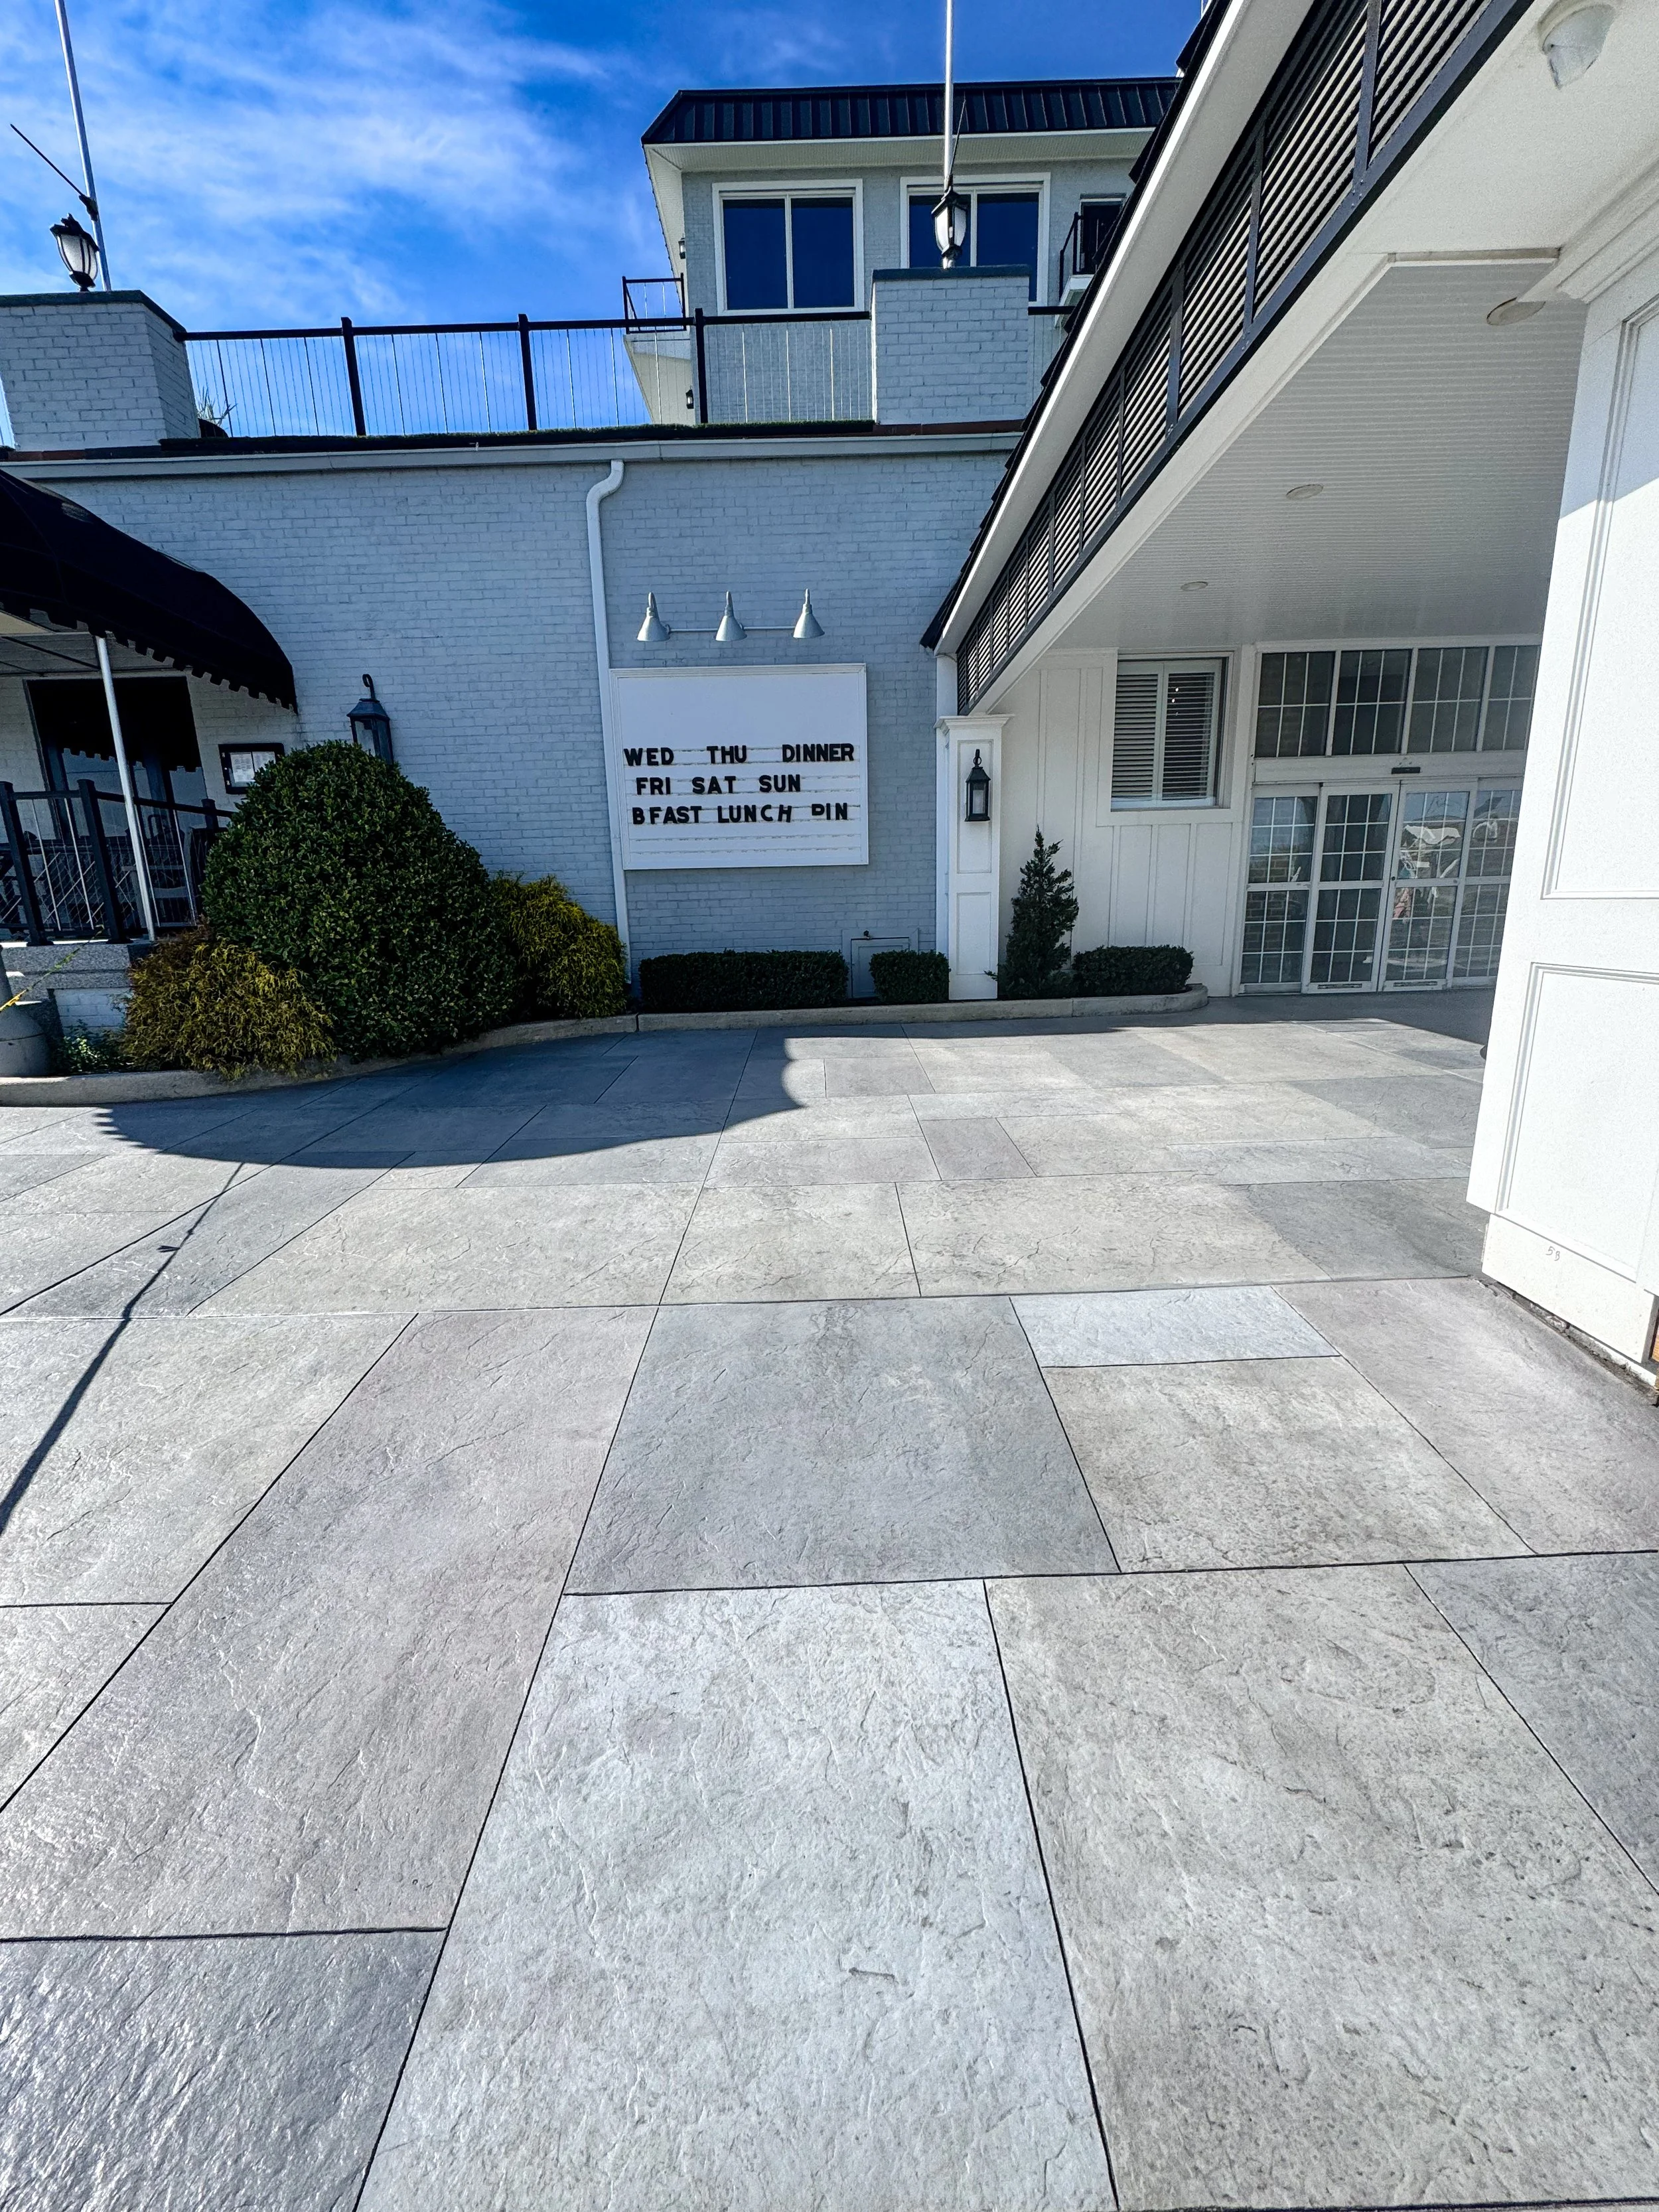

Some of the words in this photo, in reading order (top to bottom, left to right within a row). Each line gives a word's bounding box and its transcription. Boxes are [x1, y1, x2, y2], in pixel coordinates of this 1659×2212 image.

[624, 747, 674, 766] WED
[707, 745, 747, 764] THU
[782, 743, 854, 762] DINNER
[636, 777, 670, 795] FRI
[692, 776, 736, 794] SAT
[758, 774, 800, 792] SUN
[717, 804, 792, 823] LUNCH
